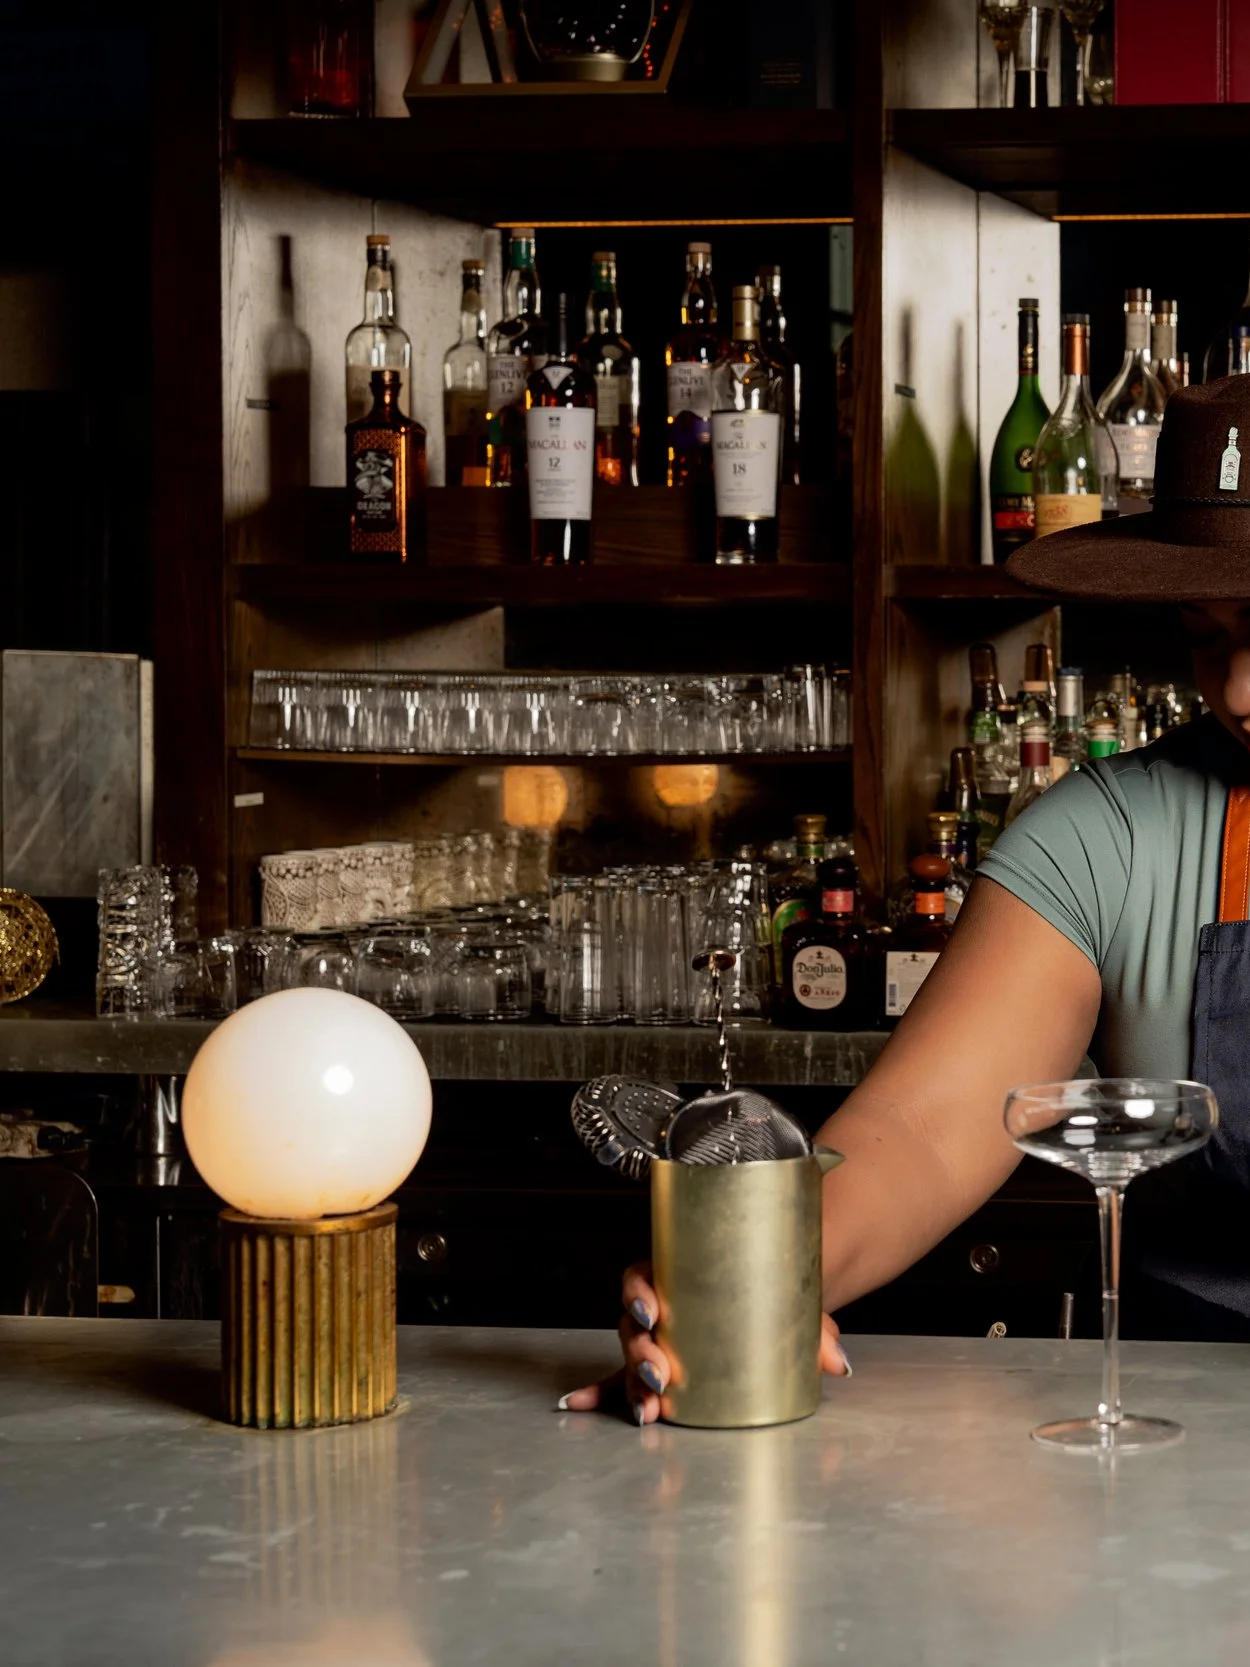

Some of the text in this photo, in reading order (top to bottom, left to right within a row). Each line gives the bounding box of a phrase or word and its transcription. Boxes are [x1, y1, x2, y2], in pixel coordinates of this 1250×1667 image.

[501, 381, 514, 394] 12
[548, 457, 561, 469] 12
[732, 463, 748, 476] 18
[356, 501, 392, 511] DEACON
[796, 962, 844, 977] Don Julio
